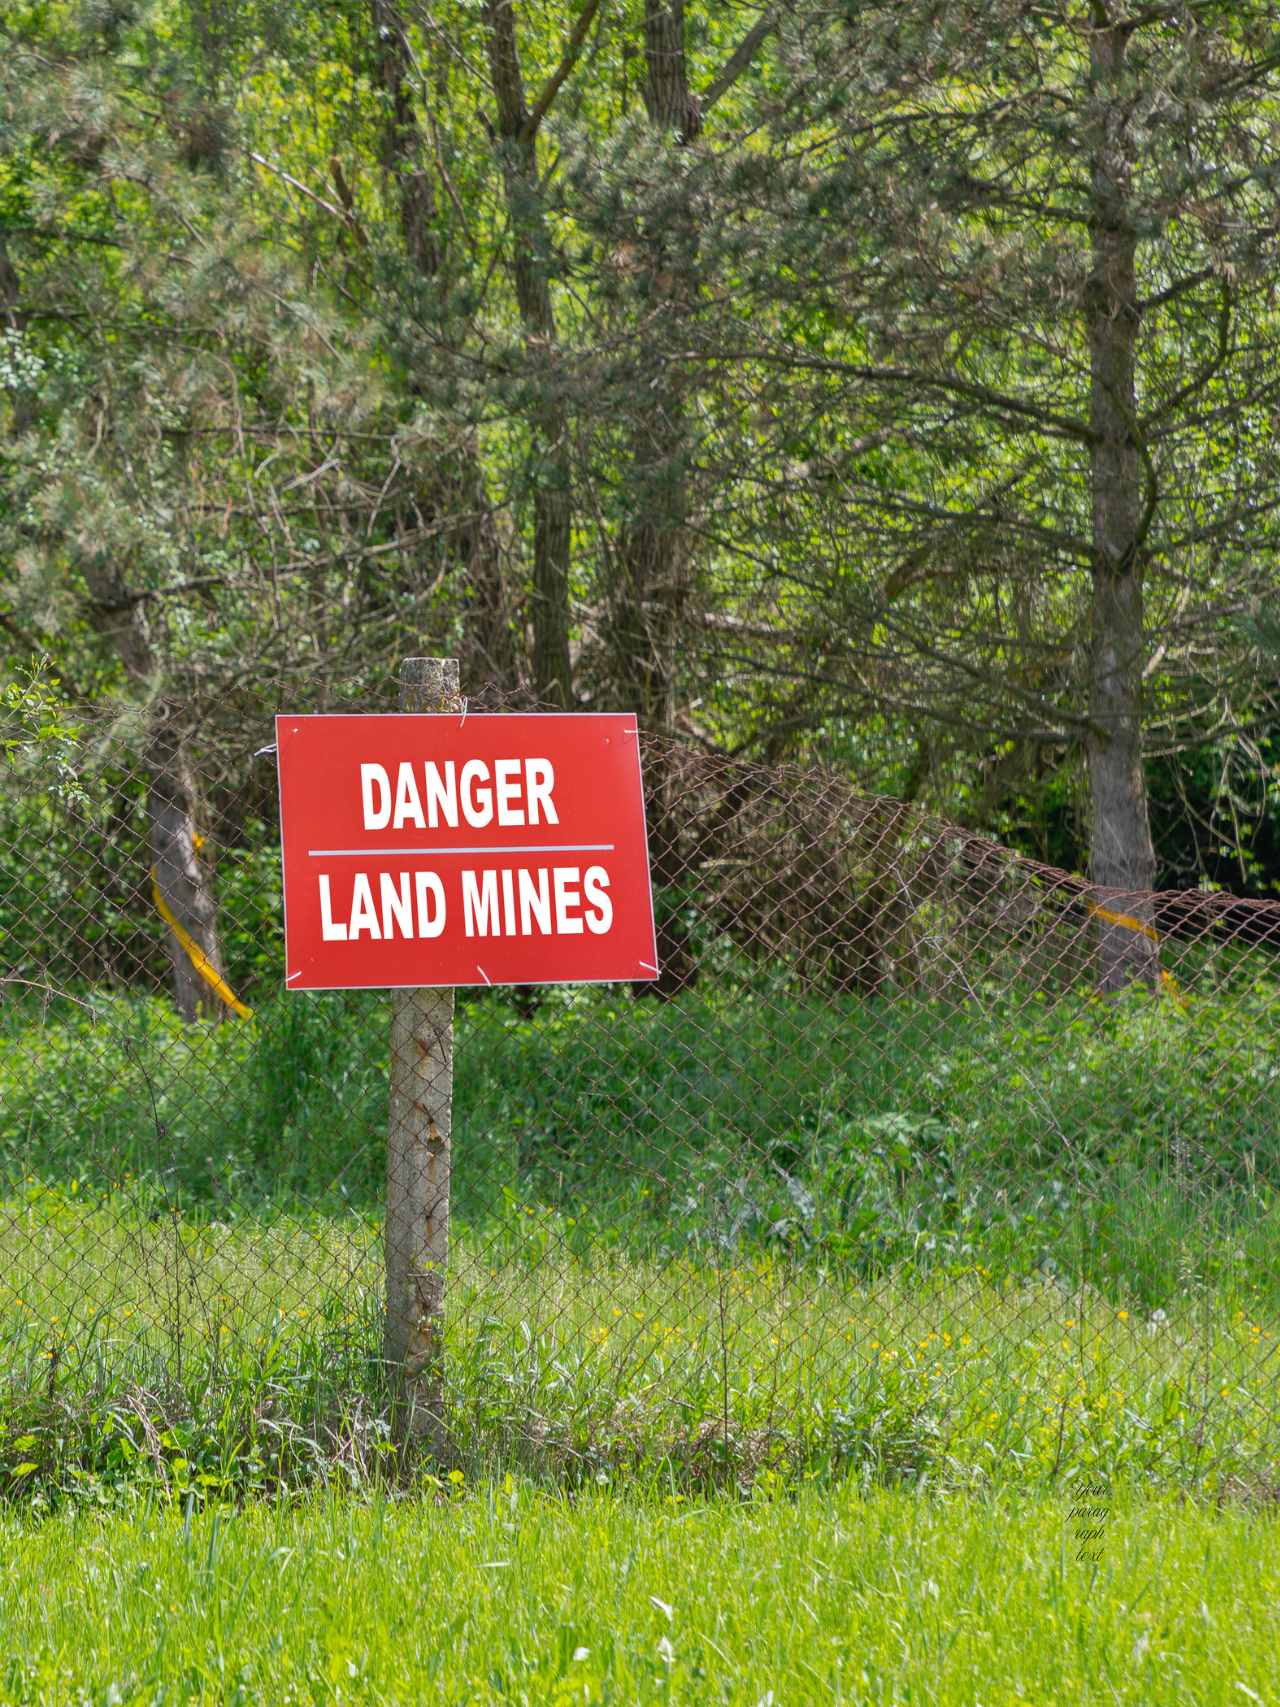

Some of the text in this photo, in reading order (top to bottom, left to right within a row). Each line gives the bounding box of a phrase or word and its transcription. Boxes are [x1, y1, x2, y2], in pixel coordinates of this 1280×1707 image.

[360, 758, 560, 830] DANGER
[319, 865, 613, 941] LAND MINES
